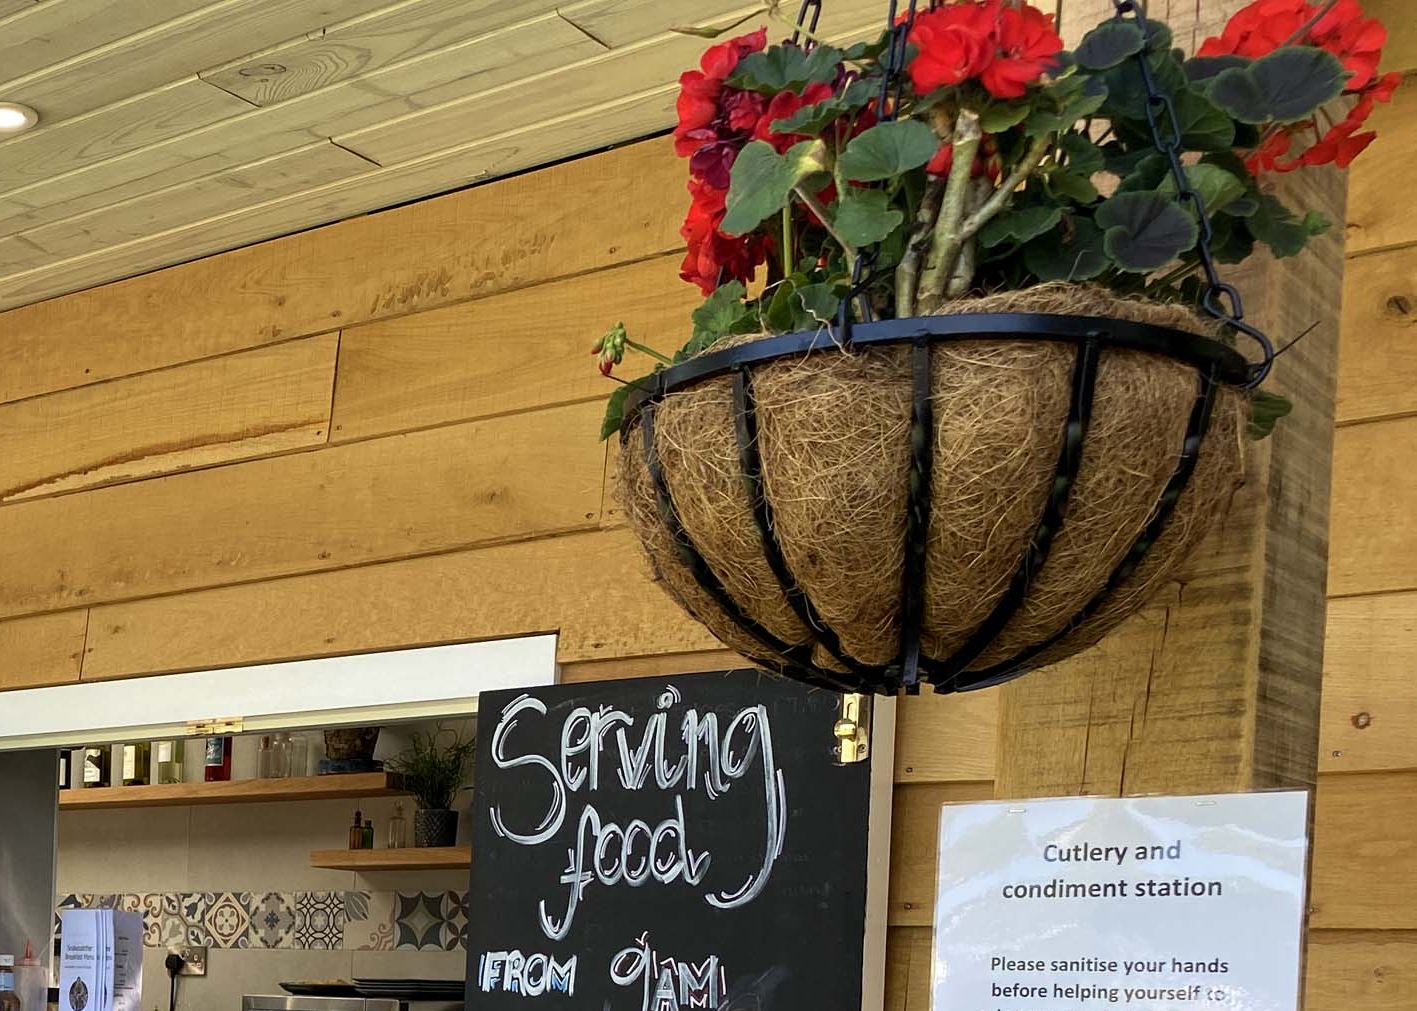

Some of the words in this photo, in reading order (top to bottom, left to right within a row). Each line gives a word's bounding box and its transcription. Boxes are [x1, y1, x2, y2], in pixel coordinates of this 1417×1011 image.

[489, 685, 787, 909] Serving
[1043, 842, 1128, 865] Cutlery
[1135, 840, 1182, 860] and
[539, 795, 711, 940] food
[1002, 879, 1128, 899] condiment
[1134, 877, 1222, 897] station
[478, 950, 578, 997] FROM
[991, 957, 1045, 972] Please
[1050, 957, 1118, 973] sanitise
[1124, 961, 1166, 975] your
[1171, 958, 1229, 973] hands
[991, 982, 1048, 998] before
[1053, 984, 1119, 1003] helping
[1124, 986, 1201, 1003] yourself
